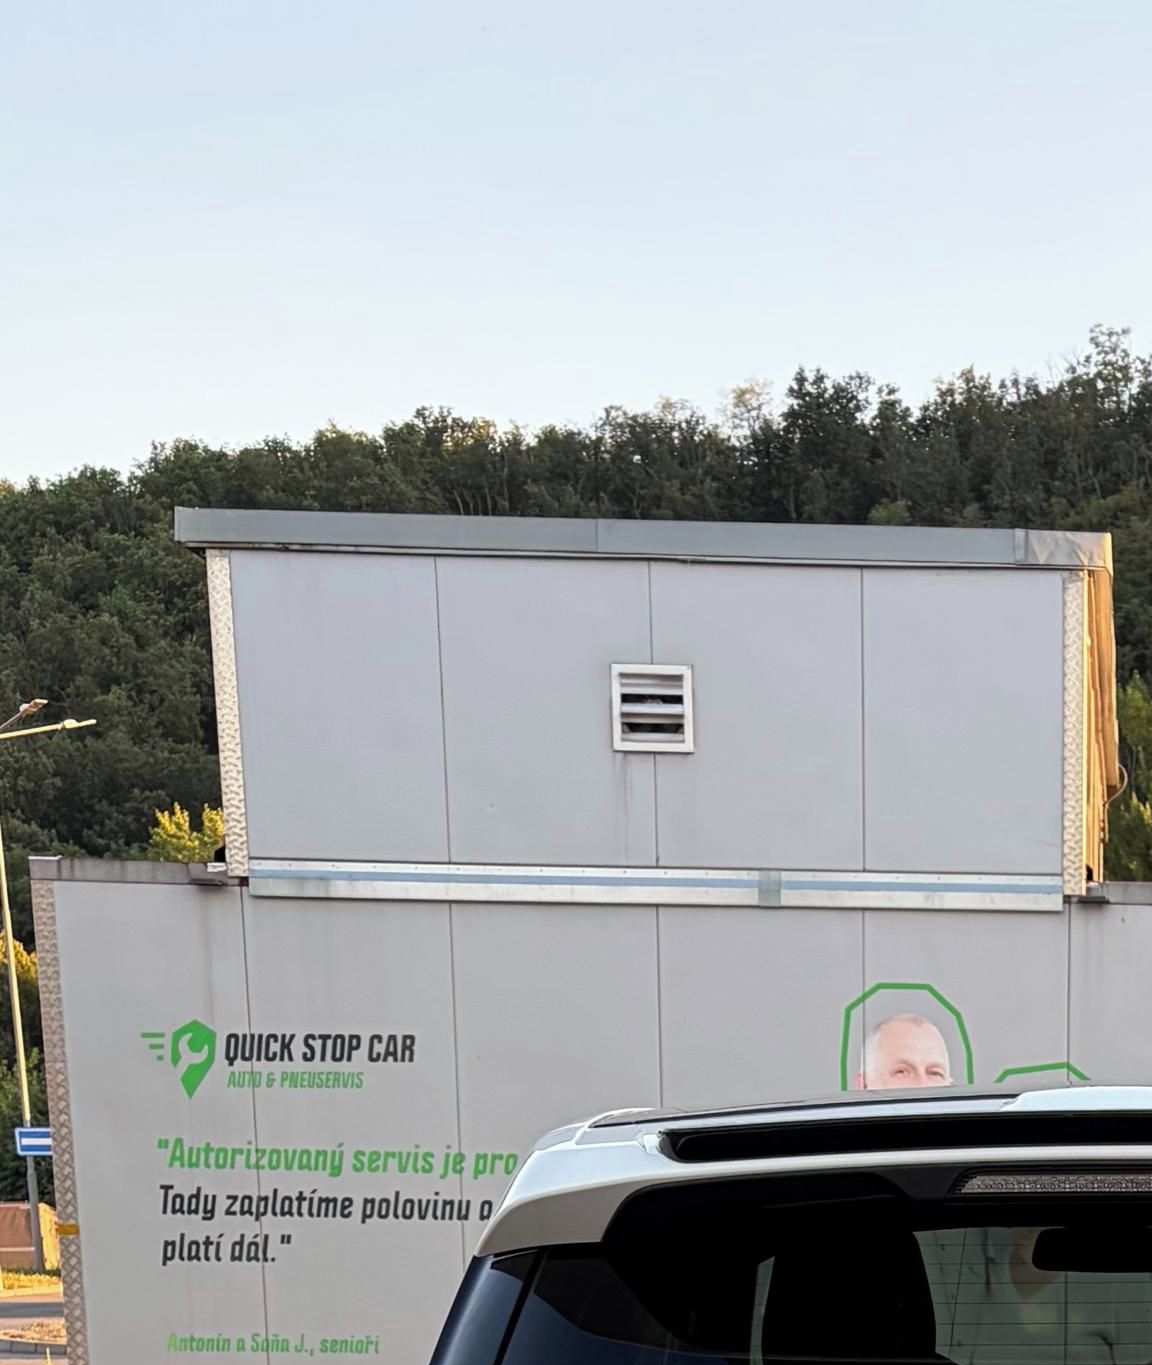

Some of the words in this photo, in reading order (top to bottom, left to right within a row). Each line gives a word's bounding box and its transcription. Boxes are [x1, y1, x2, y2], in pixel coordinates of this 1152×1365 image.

[224, 1032, 296, 1067] QUICK
[302, 1033, 362, 1063] STOP
[367, 1033, 416, 1063] CAR
[227, 1070, 262, 1089] AUTO
[265, 1071, 276, 1089] &
[280, 1071, 364, 1089] PNEUSERVIS
[157, 1137, 345, 1178] "Autorizovaný
[352, 1144, 435, 1175] servis
[439, 1145, 466, 1180] je
[159, 1184, 217, 1221] Tady
[224, 1188, 354, 1222] zaplatíme
[361, 1190, 471, 1225] polovinu
[162, 1232, 224, 1267] platí
[167, 1332, 231, 1353] Antonín
[236, 1337, 246, 1353] a
[251, 1333, 290, 1354] Soňa
[319, 1335, 380, 1355] senioři
